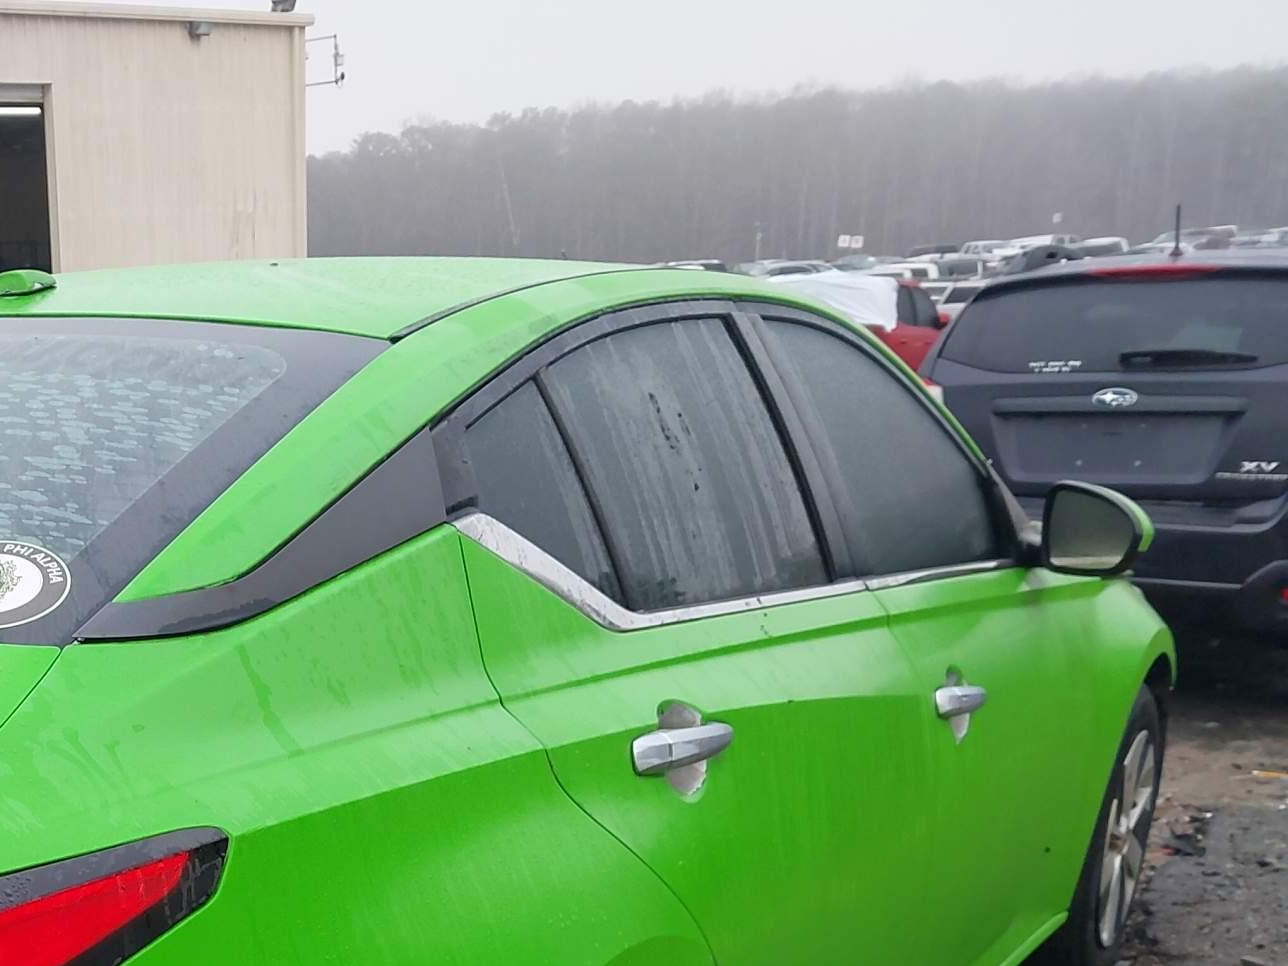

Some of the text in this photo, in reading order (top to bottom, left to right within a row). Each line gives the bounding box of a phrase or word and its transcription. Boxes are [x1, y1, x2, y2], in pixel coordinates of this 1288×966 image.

[1240, 461, 1280, 473] XV
[3, 543, 32, 556] PHI
[30, 549, 64, 585] ALPHA
